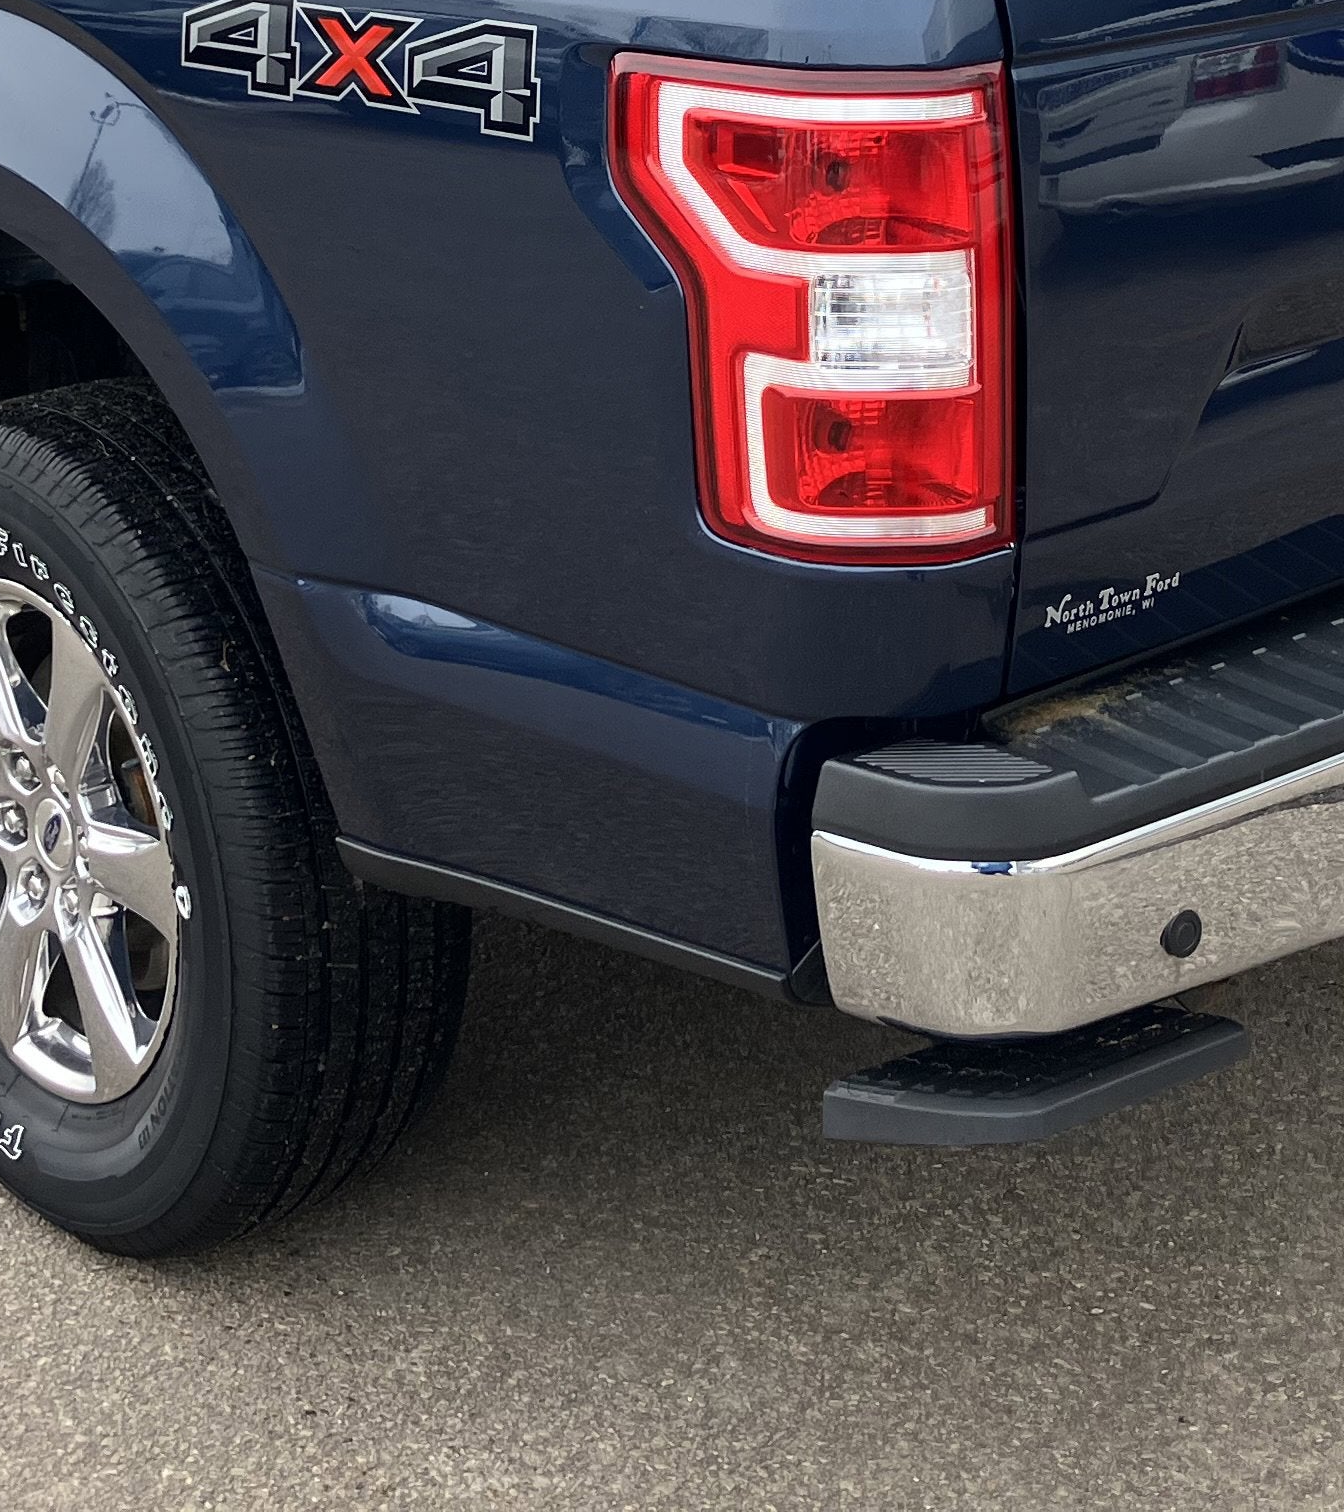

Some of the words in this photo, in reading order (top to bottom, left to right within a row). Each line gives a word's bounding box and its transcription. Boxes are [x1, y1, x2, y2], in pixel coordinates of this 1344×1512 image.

[1044, 593, 1094, 628] North
[1099, 587, 1140, 611] Town
[1143, 571, 1182, 597] Ford
[1066, 604, 1136, 634] MENOMONIE,
[1141, 597, 1155, 611] WI
